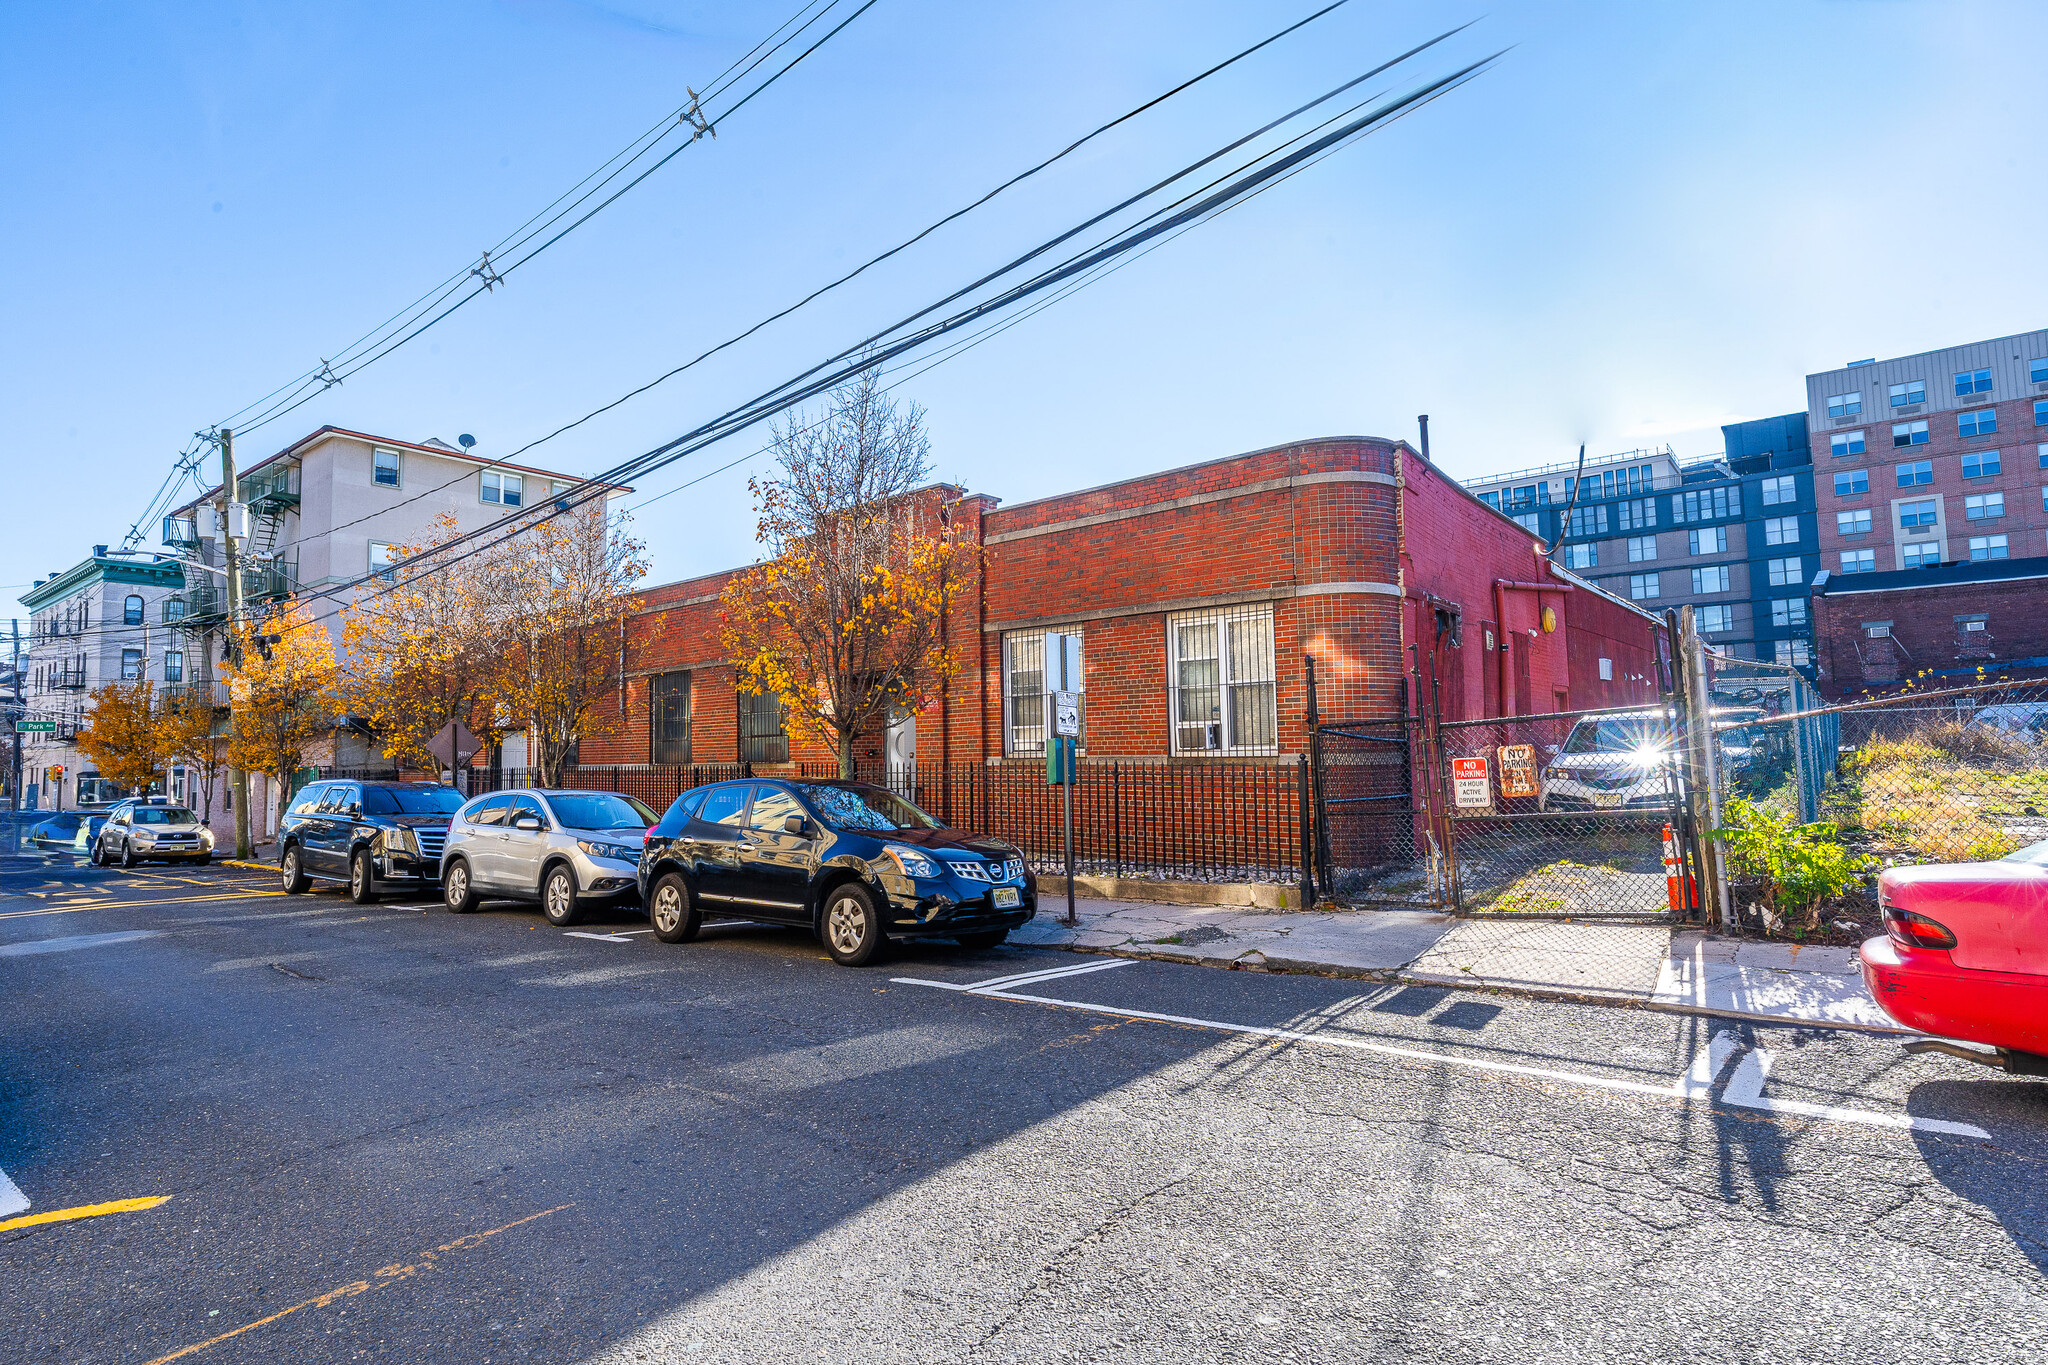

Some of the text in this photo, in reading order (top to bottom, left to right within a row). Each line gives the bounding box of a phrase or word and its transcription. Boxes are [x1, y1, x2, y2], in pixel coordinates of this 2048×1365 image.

[1508, 749, 1524, 759] NO
[1503, 759, 1533, 769] PARKING
[1456, 770, 1486, 778] PARKING
